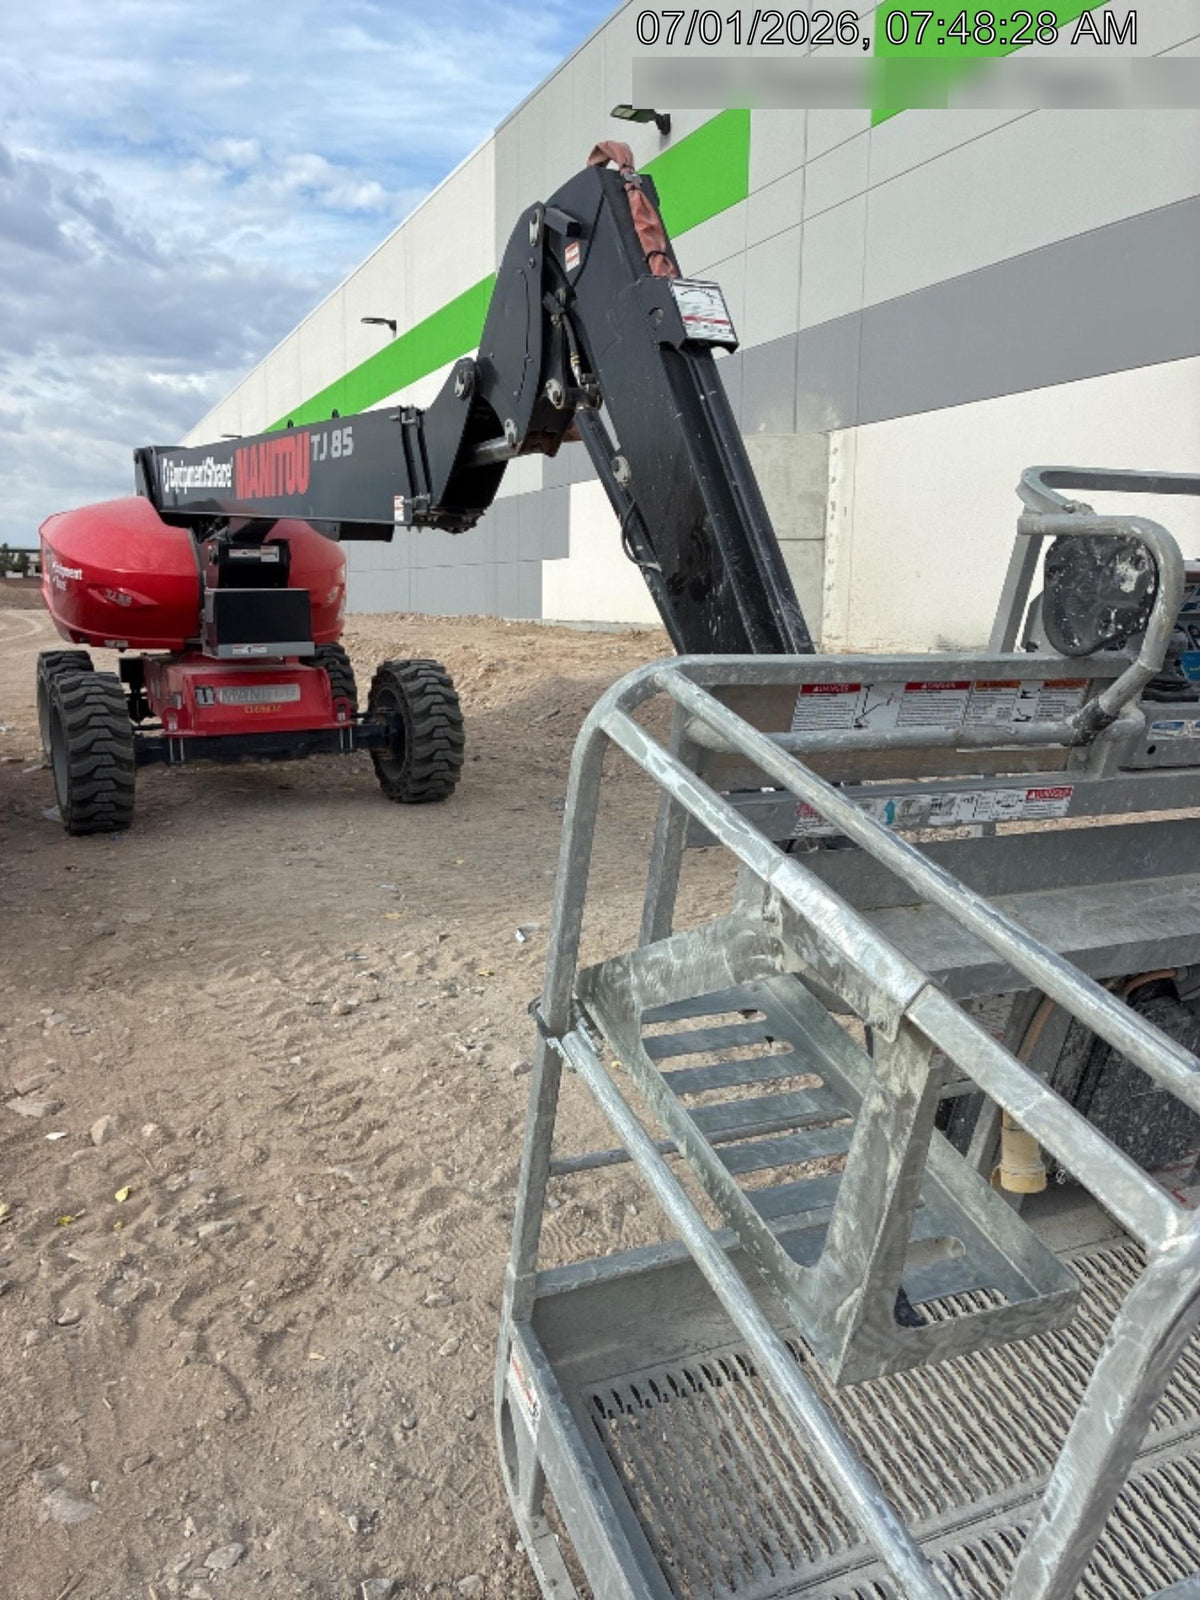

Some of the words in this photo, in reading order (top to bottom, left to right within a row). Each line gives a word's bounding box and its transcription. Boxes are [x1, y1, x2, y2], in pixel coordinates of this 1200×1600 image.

[235, 431, 310, 499] MANITOU
[310, 437, 326, 461] TJ
[331, 426, 353, 458] 85
